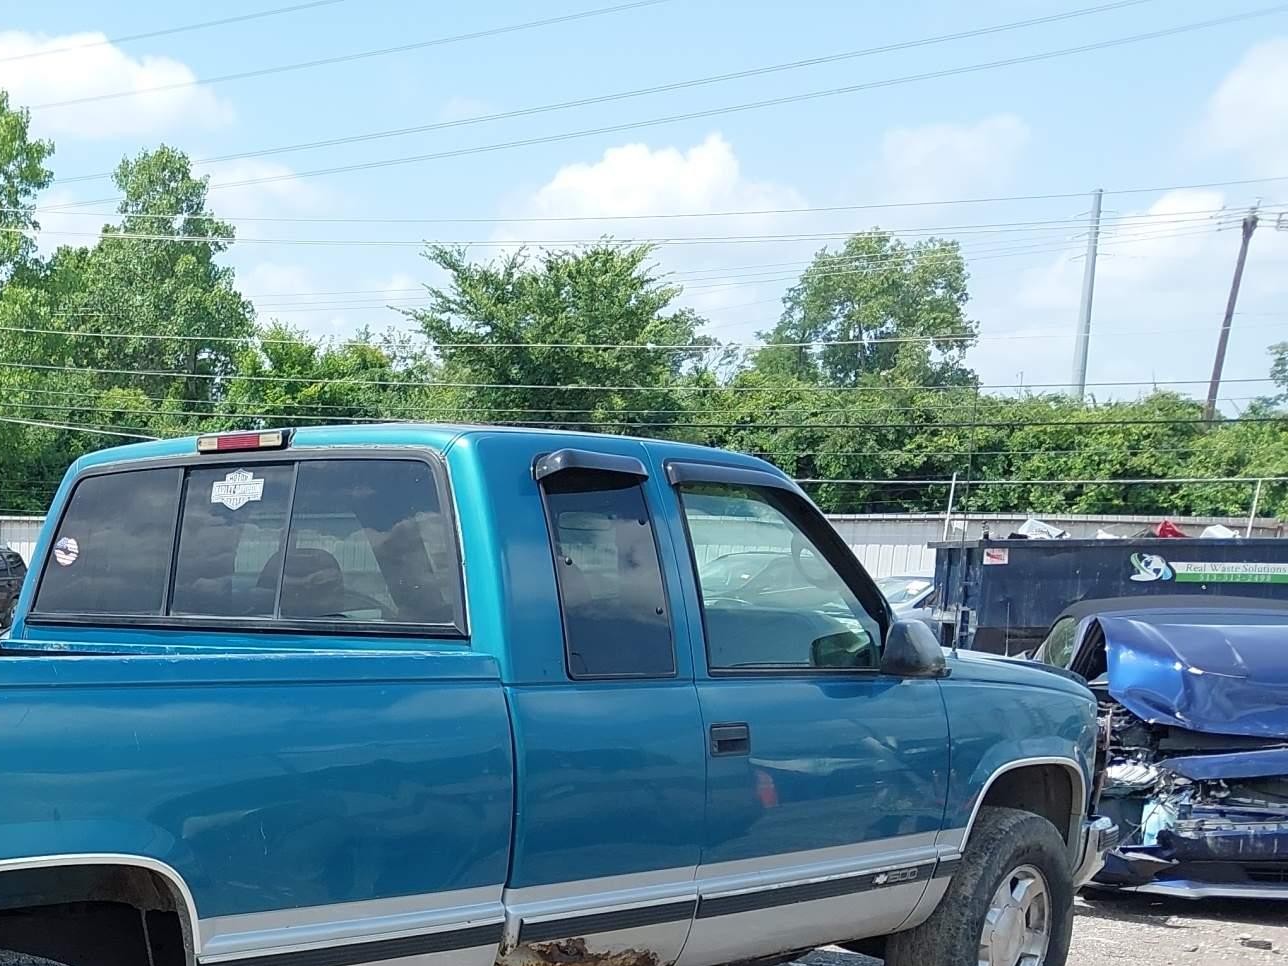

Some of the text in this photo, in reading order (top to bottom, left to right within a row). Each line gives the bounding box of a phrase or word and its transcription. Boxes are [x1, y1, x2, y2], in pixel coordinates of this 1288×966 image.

[1186, 563, 1287, 573] Real Waste Solutions
